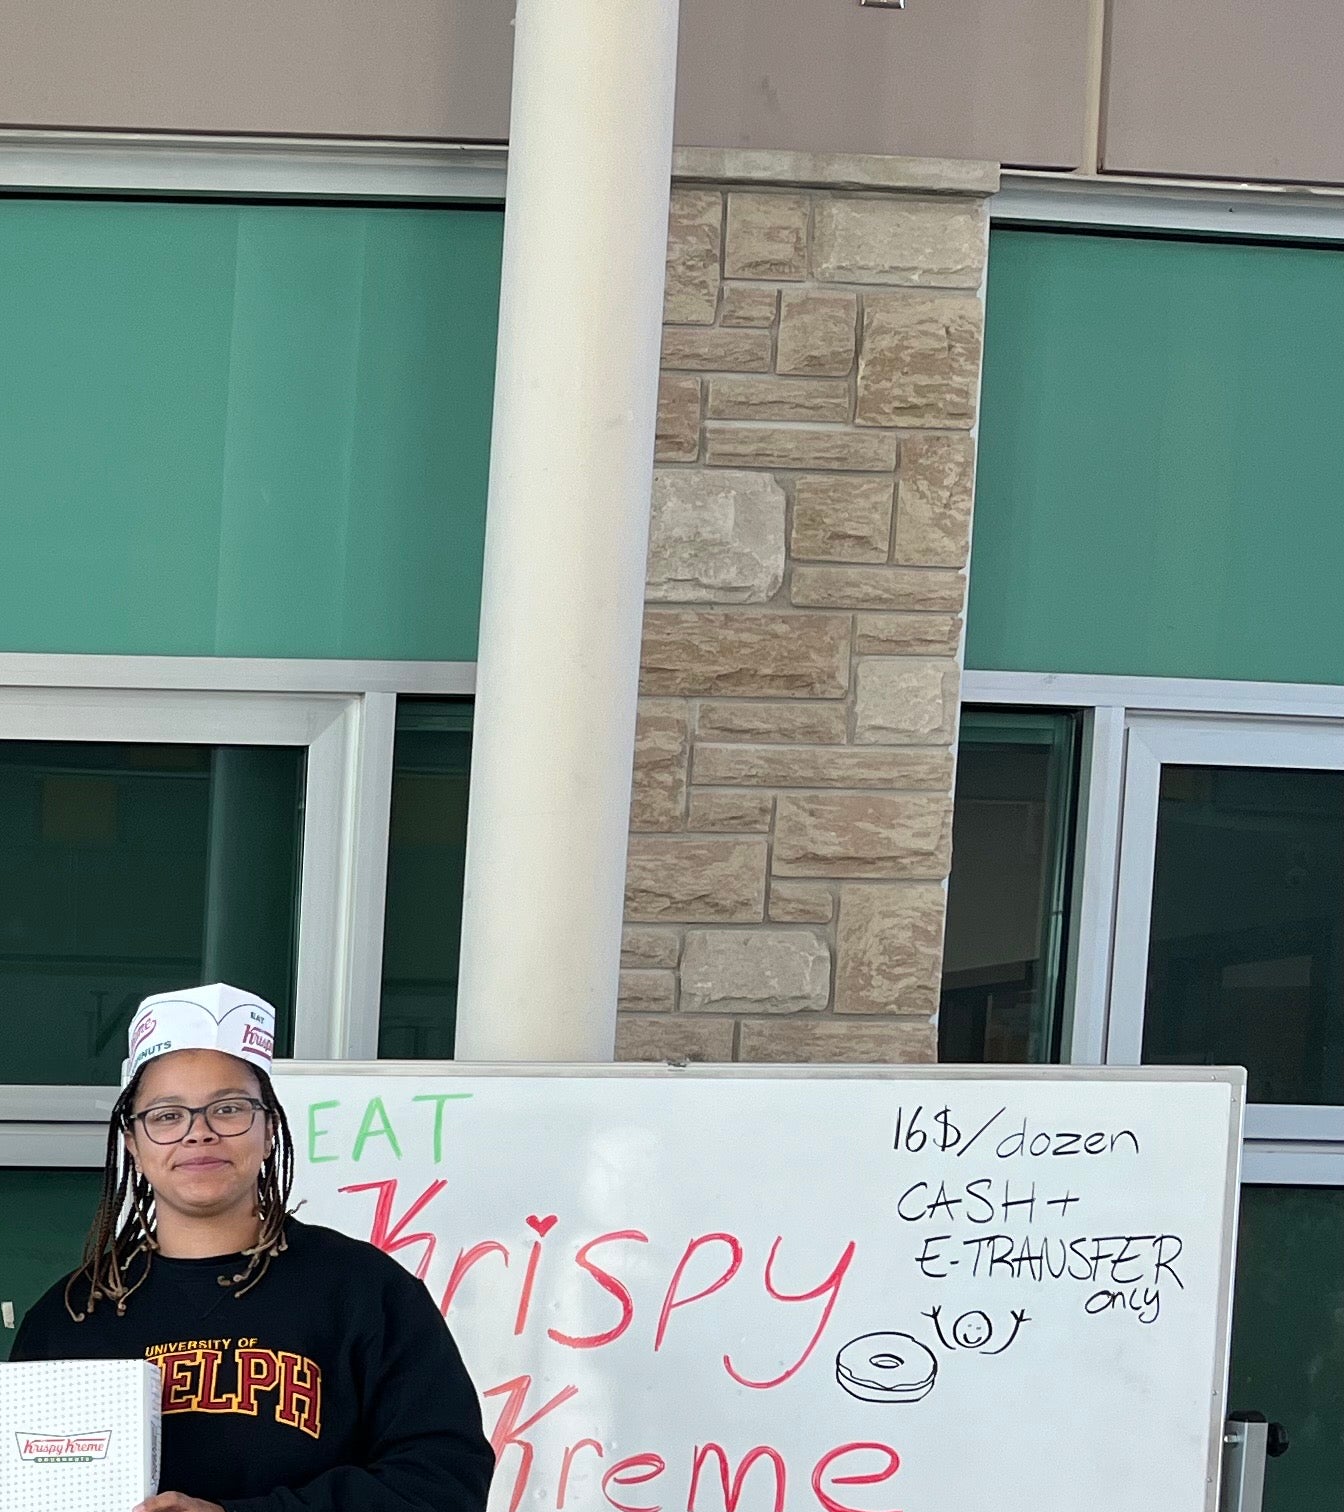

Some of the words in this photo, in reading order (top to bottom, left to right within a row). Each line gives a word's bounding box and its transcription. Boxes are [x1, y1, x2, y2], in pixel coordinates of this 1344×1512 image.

[242, 1024, 274, 1051] Krisp
[311, 1093, 474, 1165] EAT
[338, 1179, 857, 1390] Krispy
[145, 1339, 231, 1356] UNIVERSITY
[238, 1337, 258, 1348] OF
[24, 1439, 65, 1455] Krispy
[65, 1438, 106, 1453] Kreme
